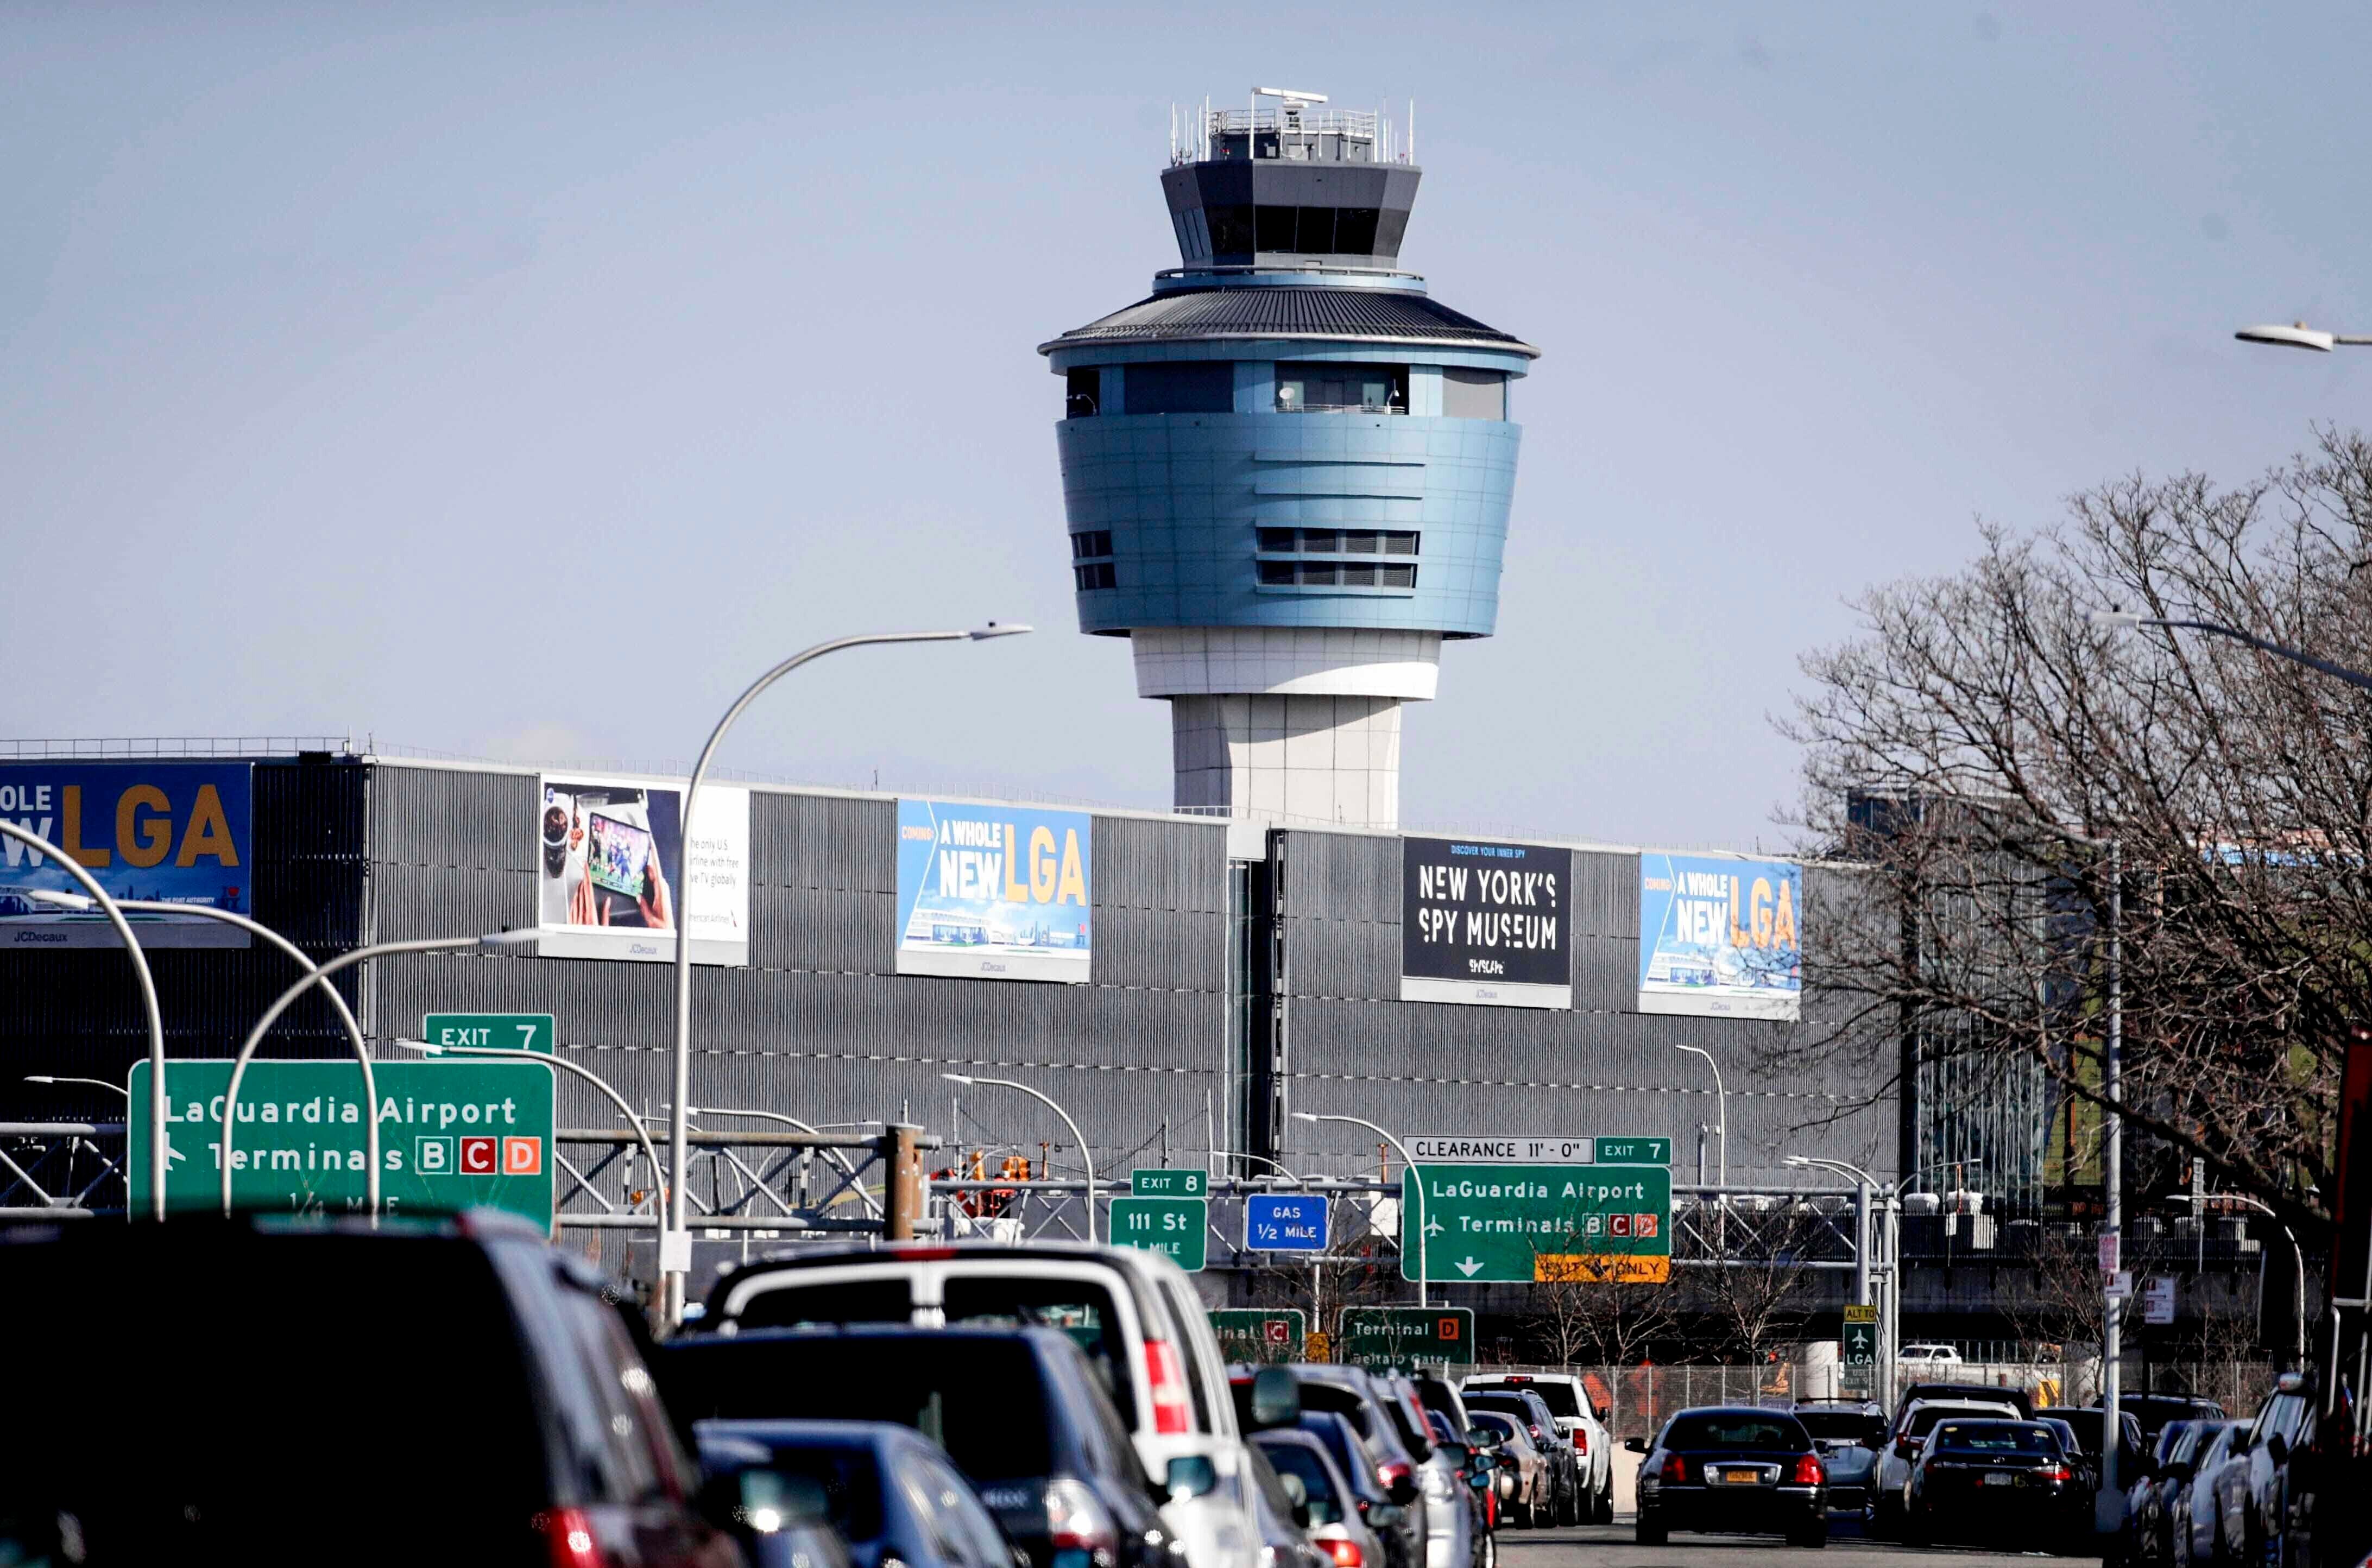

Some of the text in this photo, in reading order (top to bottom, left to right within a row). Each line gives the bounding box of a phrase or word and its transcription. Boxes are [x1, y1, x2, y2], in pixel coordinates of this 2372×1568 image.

[0, 785, 52, 811] OLE
[62, 784, 239, 867] LGA
[902, 825, 932, 840] COMING
[940, 819, 1001, 848] A WHOLE
[701, 838, 716, 853] only
[1451, 845, 1478, 855] DISCOVER
[1480, 846, 1496, 856] YOUR
[1515, 849, 1525, 859] SPY
[710, 856, 725, 868] with
[727, 856, 739, 868] free
[1004, 823, 1087, 907] LGA
[700, 872, 709, 884] TV
[711, 872, 737, 889] globally
[940, 850, 1002, 900] NEW
[1420, 864, 1555, 907] NEW YORK'S
[1677, 871, 1728, 897] A WHOLE
[1731, 876, 1797, 950] LGA
[1419, 907, 1556, 950] SPY MUSEUM
[1677, 899, 1728, 945] NEW
[14, 931, 68, 942] JCDecaux
[441, 1025, 537, 1049] EXIT 7
[165, 1096, 516, 1129] LaGuardia Airport
[209, 1142, 534, 1170] Terminas B C D
[1416, 1142, 1516, 1157] CLEARANCE
[1605, 1143, 1661, 1159] EXIT 7
[1141, 1175, 1197, 1192] EXIT 8
[1433, 1181, 1644, 1202] LaGuardia Airport
[347, 1196, 400, 1215] ME
[1273, 1207, 1301, 1219] GAS
[1128, 1213, 1187, 1230] 111 St
[1459, 1216, 1653, 1234] Terminals B C D
[1258, 1224, 1317, 1240] 1/2 MILE
[1150, 1242, 1181, 1255] MILE
[1617, 1262, 1660, 1275] ONLY
[1846, 1309, 1875, 1318] ALT TO
[1218, 1325, 1283, 1340] inal C
[1354, 1321, 1454, 1337] Terminal D
[1411, 1353, 1451, 1365] Gates
[1847, 1354, 1873, 1365] LGA
